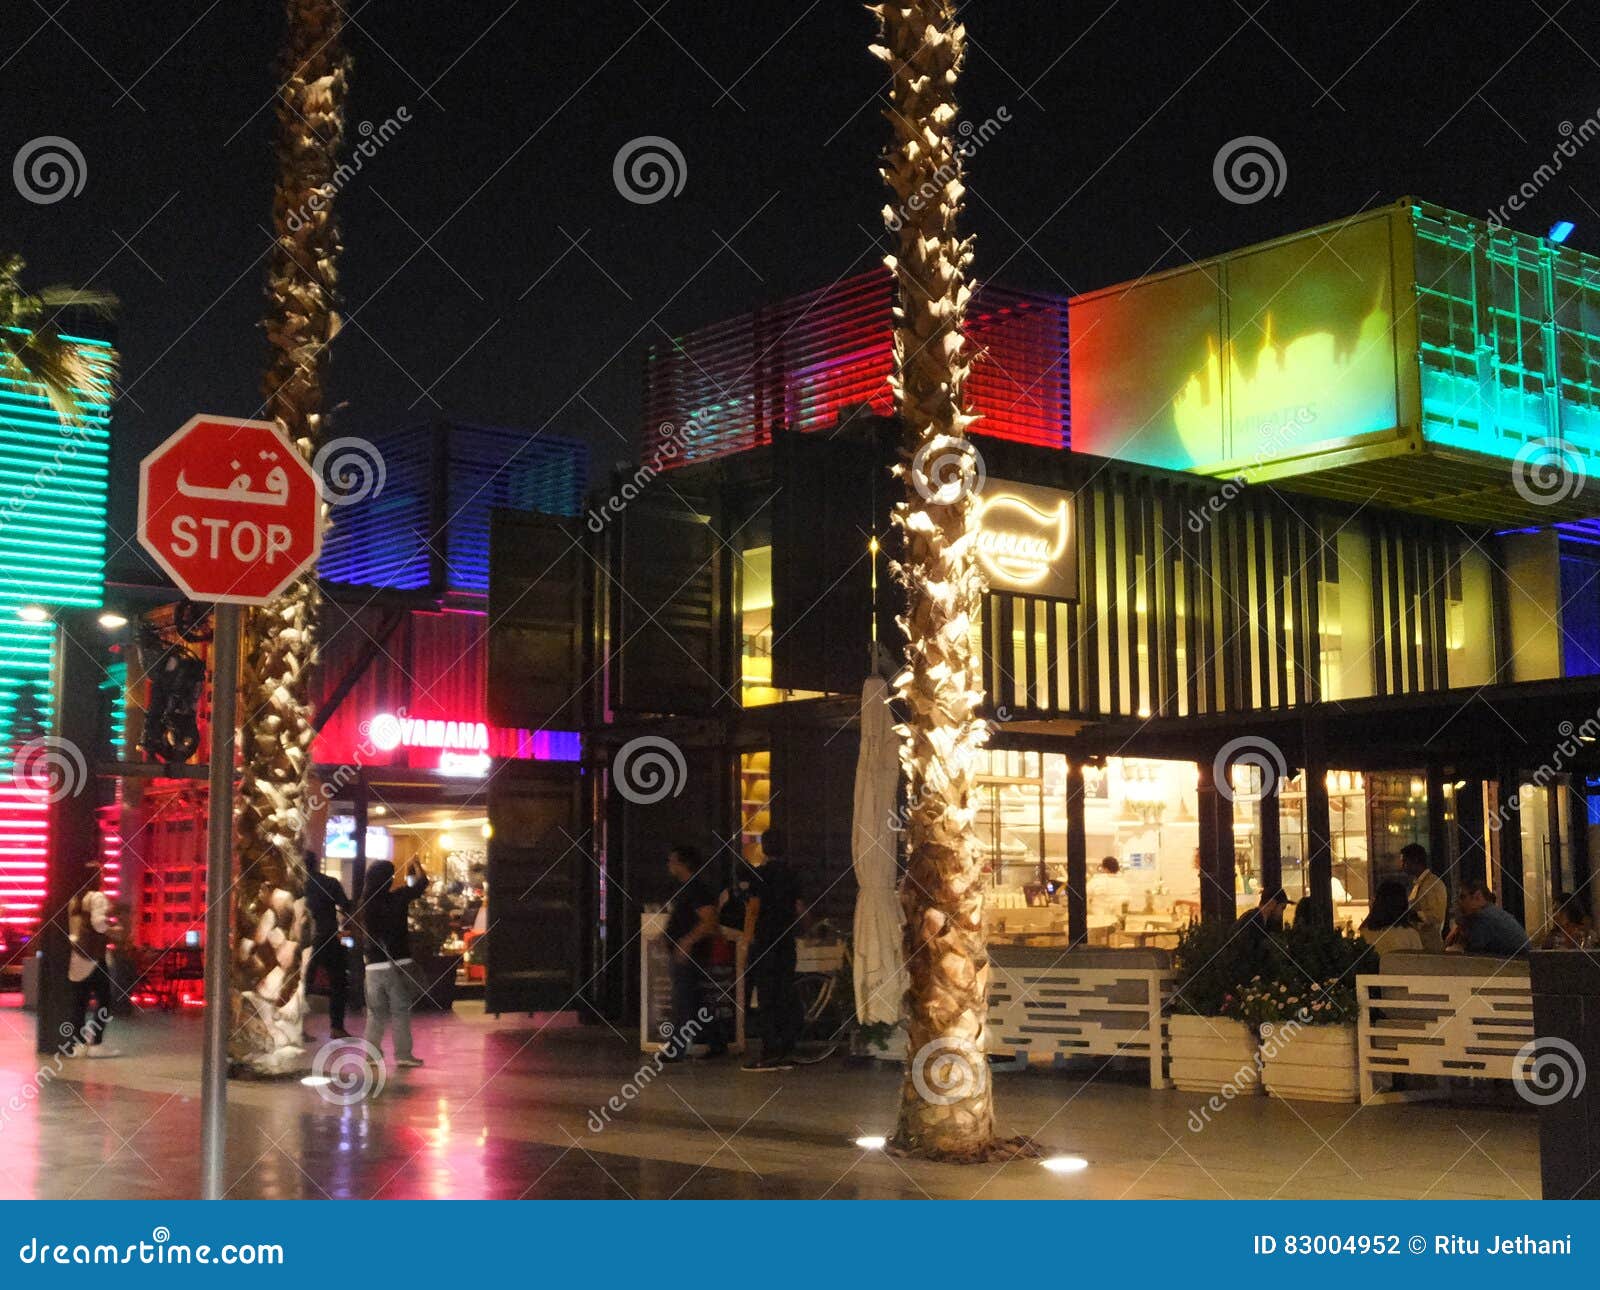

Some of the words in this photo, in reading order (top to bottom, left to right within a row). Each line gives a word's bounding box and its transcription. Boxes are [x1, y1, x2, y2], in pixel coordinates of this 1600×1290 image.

[176, 450, 289, 506] قف
[170, 514, 292, 564] STOP
[400, 717, 489, 750] YAMAHA
